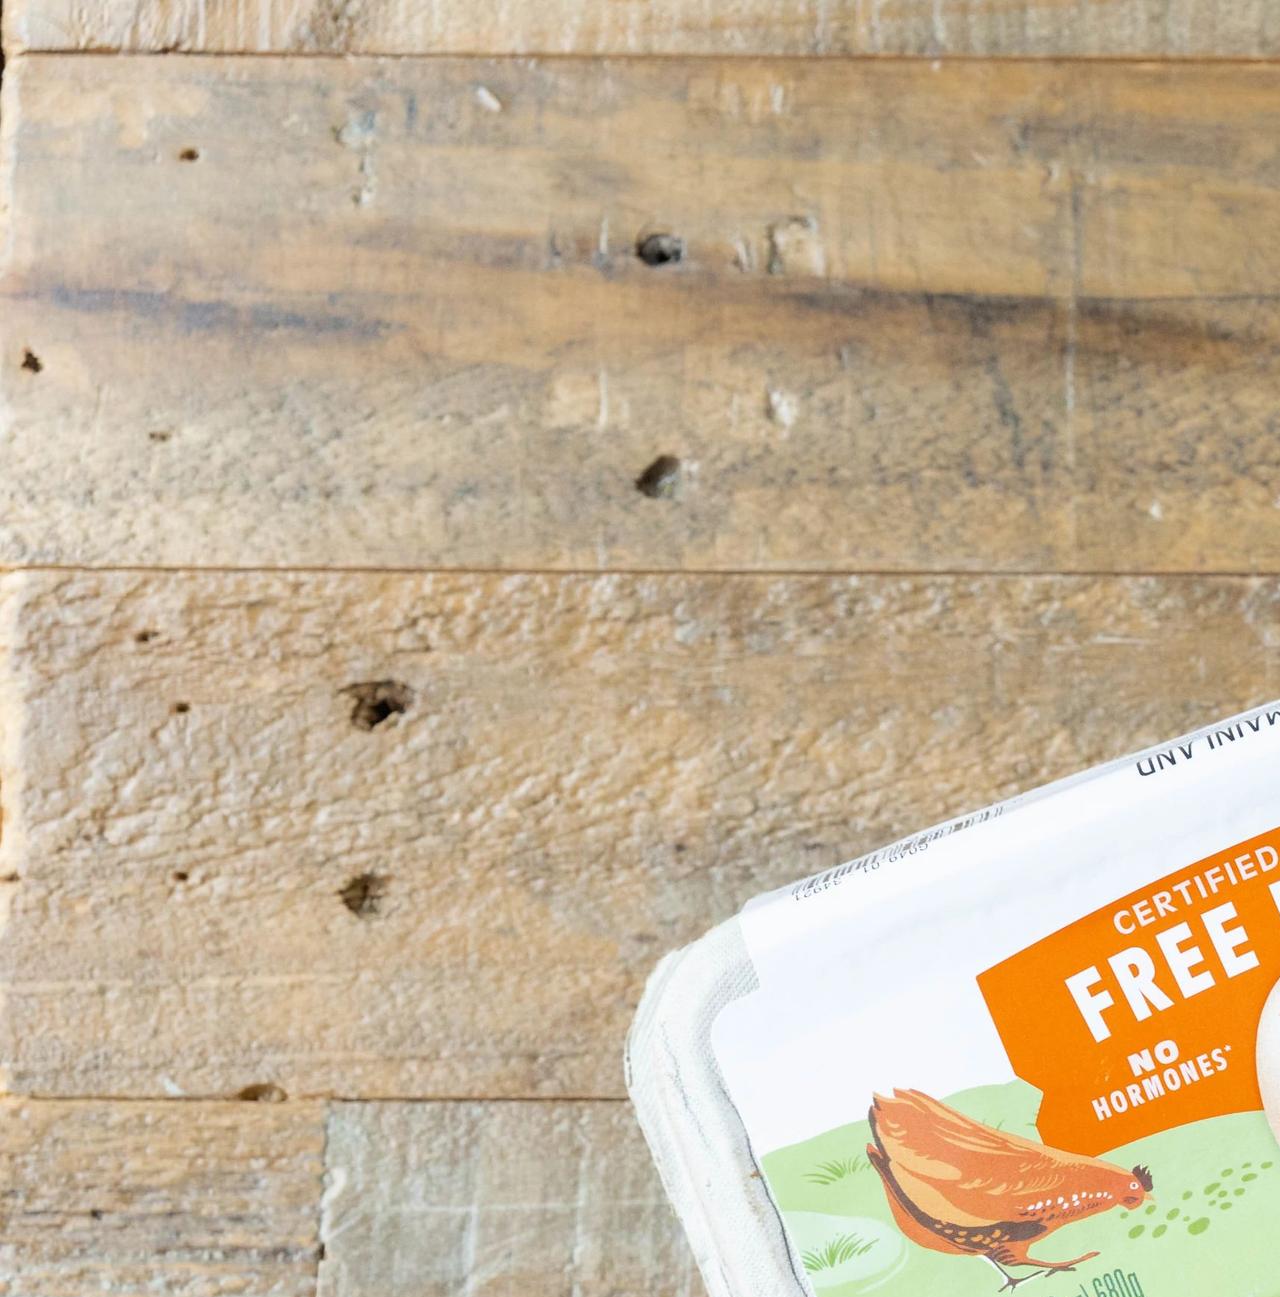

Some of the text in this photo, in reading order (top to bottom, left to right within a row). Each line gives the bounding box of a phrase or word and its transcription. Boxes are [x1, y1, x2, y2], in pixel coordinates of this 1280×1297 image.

[1114, 846, 1278, 934] CERTIFIED
[1065, 902, 1259, 1042] FREE
[1128, 1040, 1178, 1076] NO
